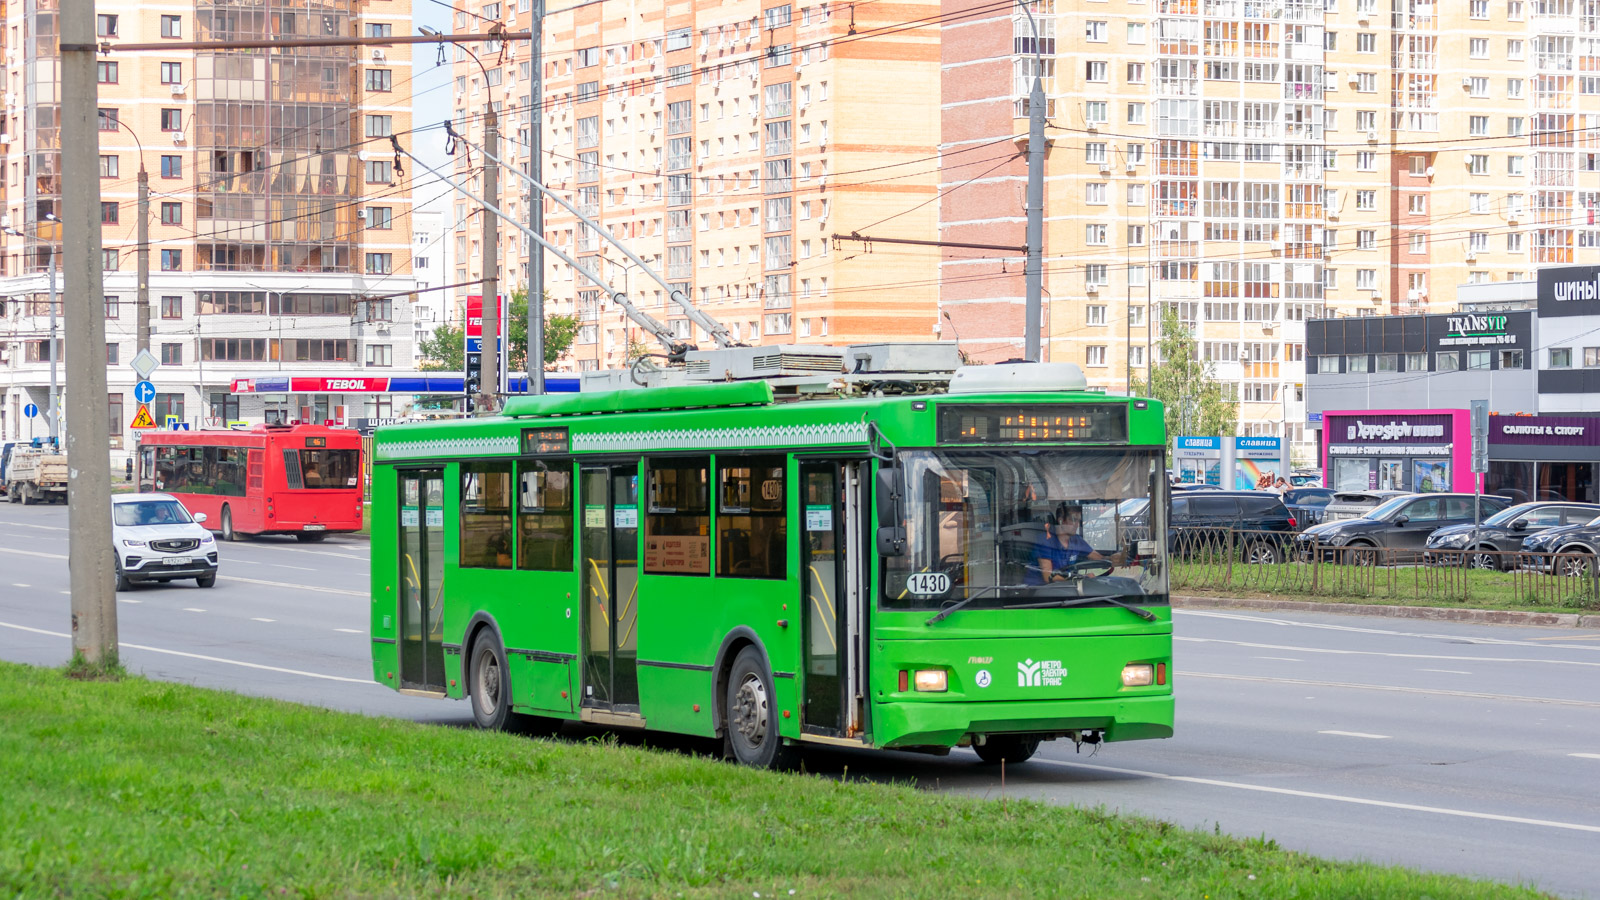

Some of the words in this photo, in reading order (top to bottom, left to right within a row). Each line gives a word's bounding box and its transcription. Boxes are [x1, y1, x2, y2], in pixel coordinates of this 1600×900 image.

[1554, 280, 1597, 301] ШИНЫ
[325, 379, 366, 390] TEBOIL
[1503, 425, 1544, 435] САЛЮТЫ
[1545, 426, 1553, 435] &
[1554, 426, 1585, 436] СПОРТ
[763, 481, 778, 498] 1430
[911, 575, 946, 592] 1430
[1041, 660, 1062, 669] МЕТРО
[1041, 668, 1068, 677] ЭЛЕКТРО
[1042, 677, 1062, 686] ТРАНС
